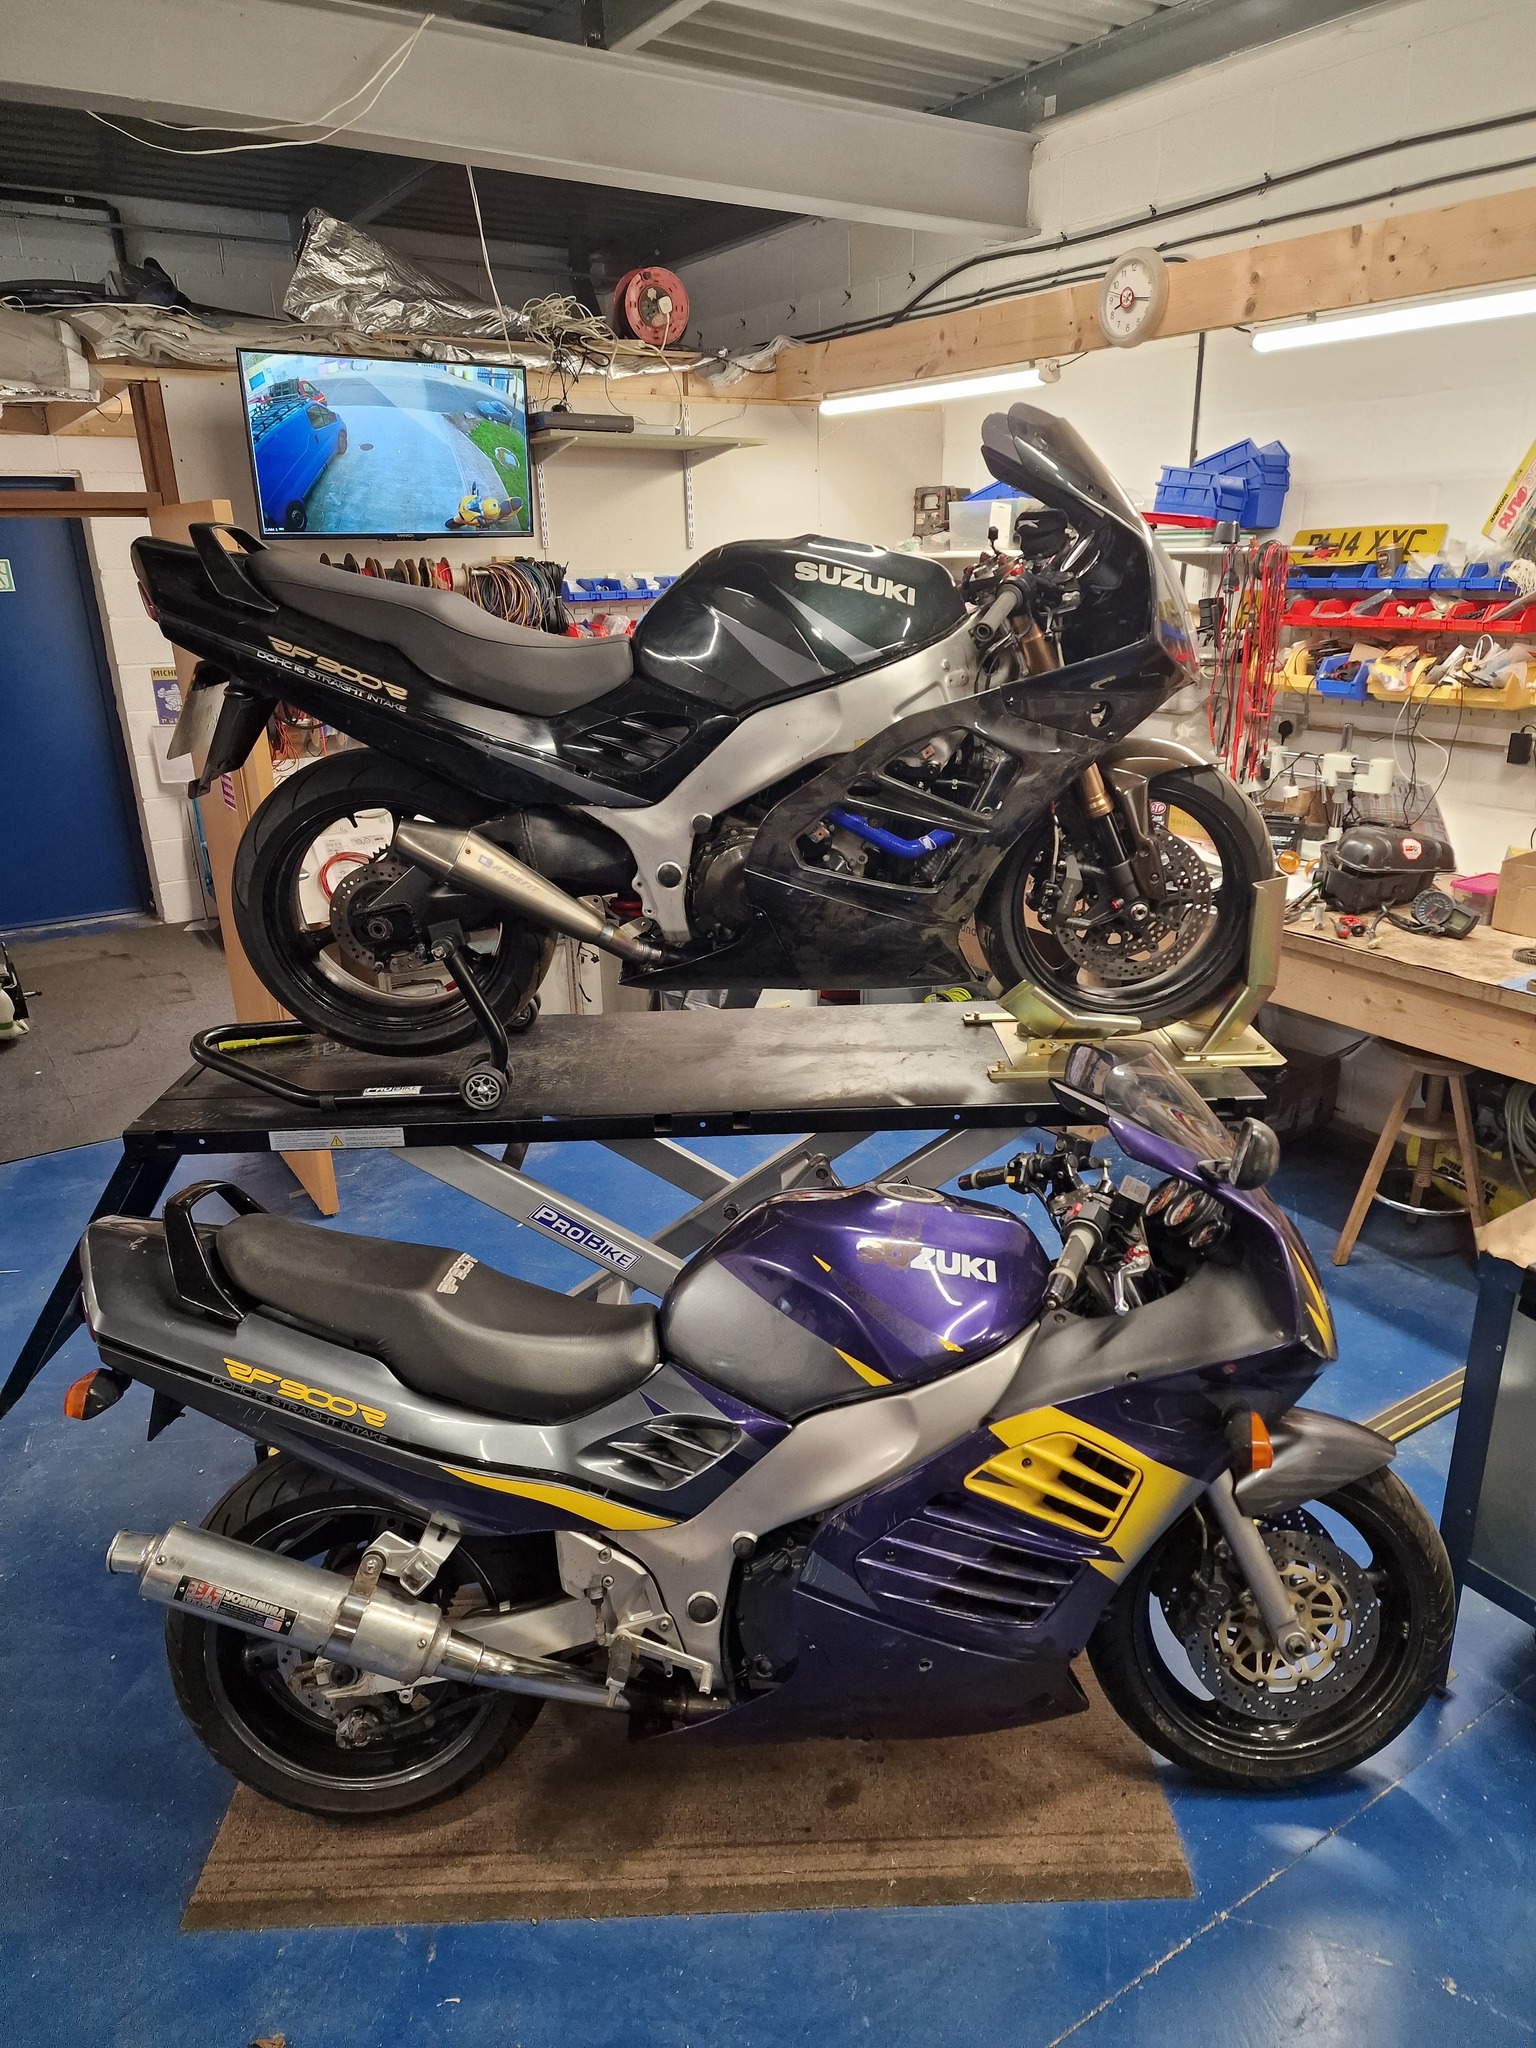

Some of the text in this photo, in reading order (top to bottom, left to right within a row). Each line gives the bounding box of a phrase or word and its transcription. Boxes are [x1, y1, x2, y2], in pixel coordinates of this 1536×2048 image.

[794, 561, 916, 606] SUZUKI
[256, 650, 408, 713] DOHC 16 STRAIGHT INTAKE
[1151, 803, 1165, 813] STP
[211, 1377, 389, 1444] DOHC 16 STRAIGHT INTAKE
[223, 1590, 286, 1619] YOSHIMURA
